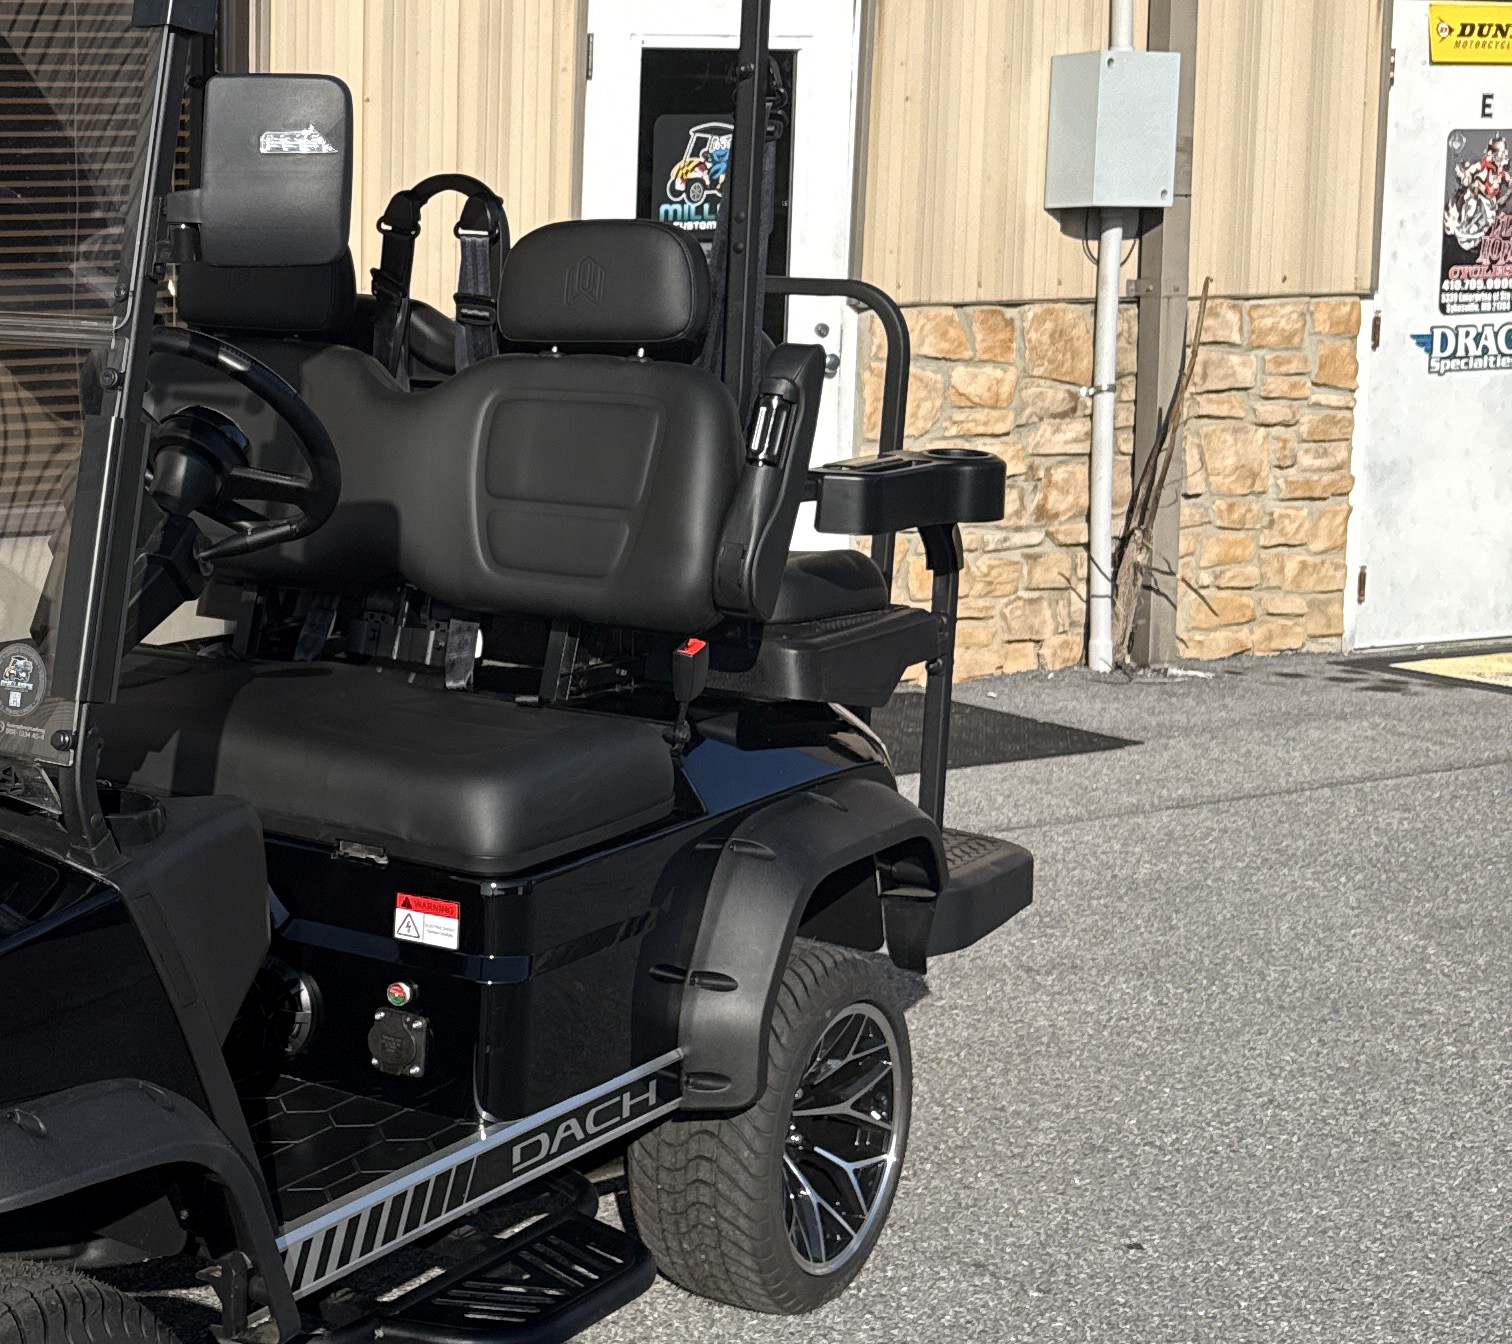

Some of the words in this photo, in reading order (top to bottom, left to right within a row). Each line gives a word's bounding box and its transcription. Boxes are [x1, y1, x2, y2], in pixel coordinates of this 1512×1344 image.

[1457, 22, 1512, 38] DUN
[1454, 39, 1511, 51] MOTORCYCL
[659, 203, 721, 222] MILL
[512, 1079, 657, 1173] DACH
